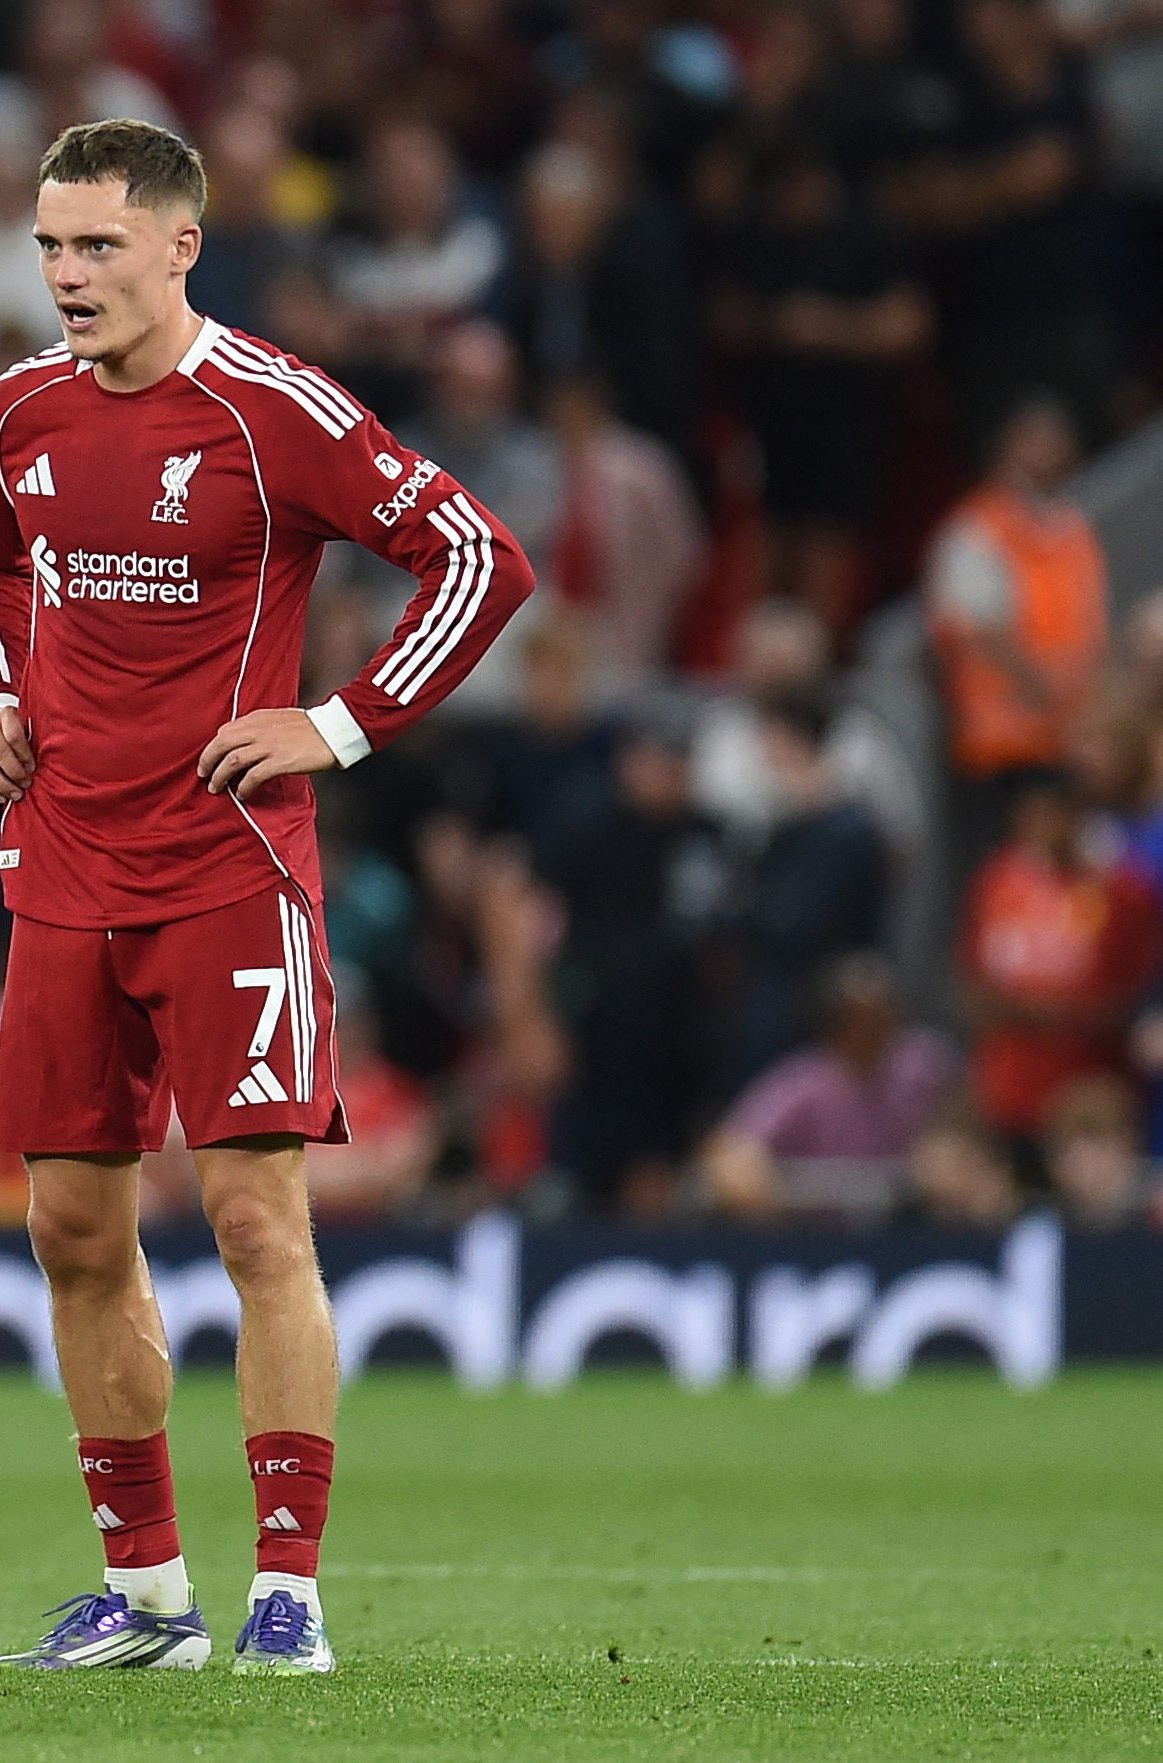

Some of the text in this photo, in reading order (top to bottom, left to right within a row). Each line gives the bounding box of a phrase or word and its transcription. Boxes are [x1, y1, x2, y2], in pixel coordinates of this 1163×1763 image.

[67, 548, 188, 578] standard
[67, 573, 199, 604] chartered
[233, 968, 286, 1057] 7
[254, 1458, 301, 1475] LFC
